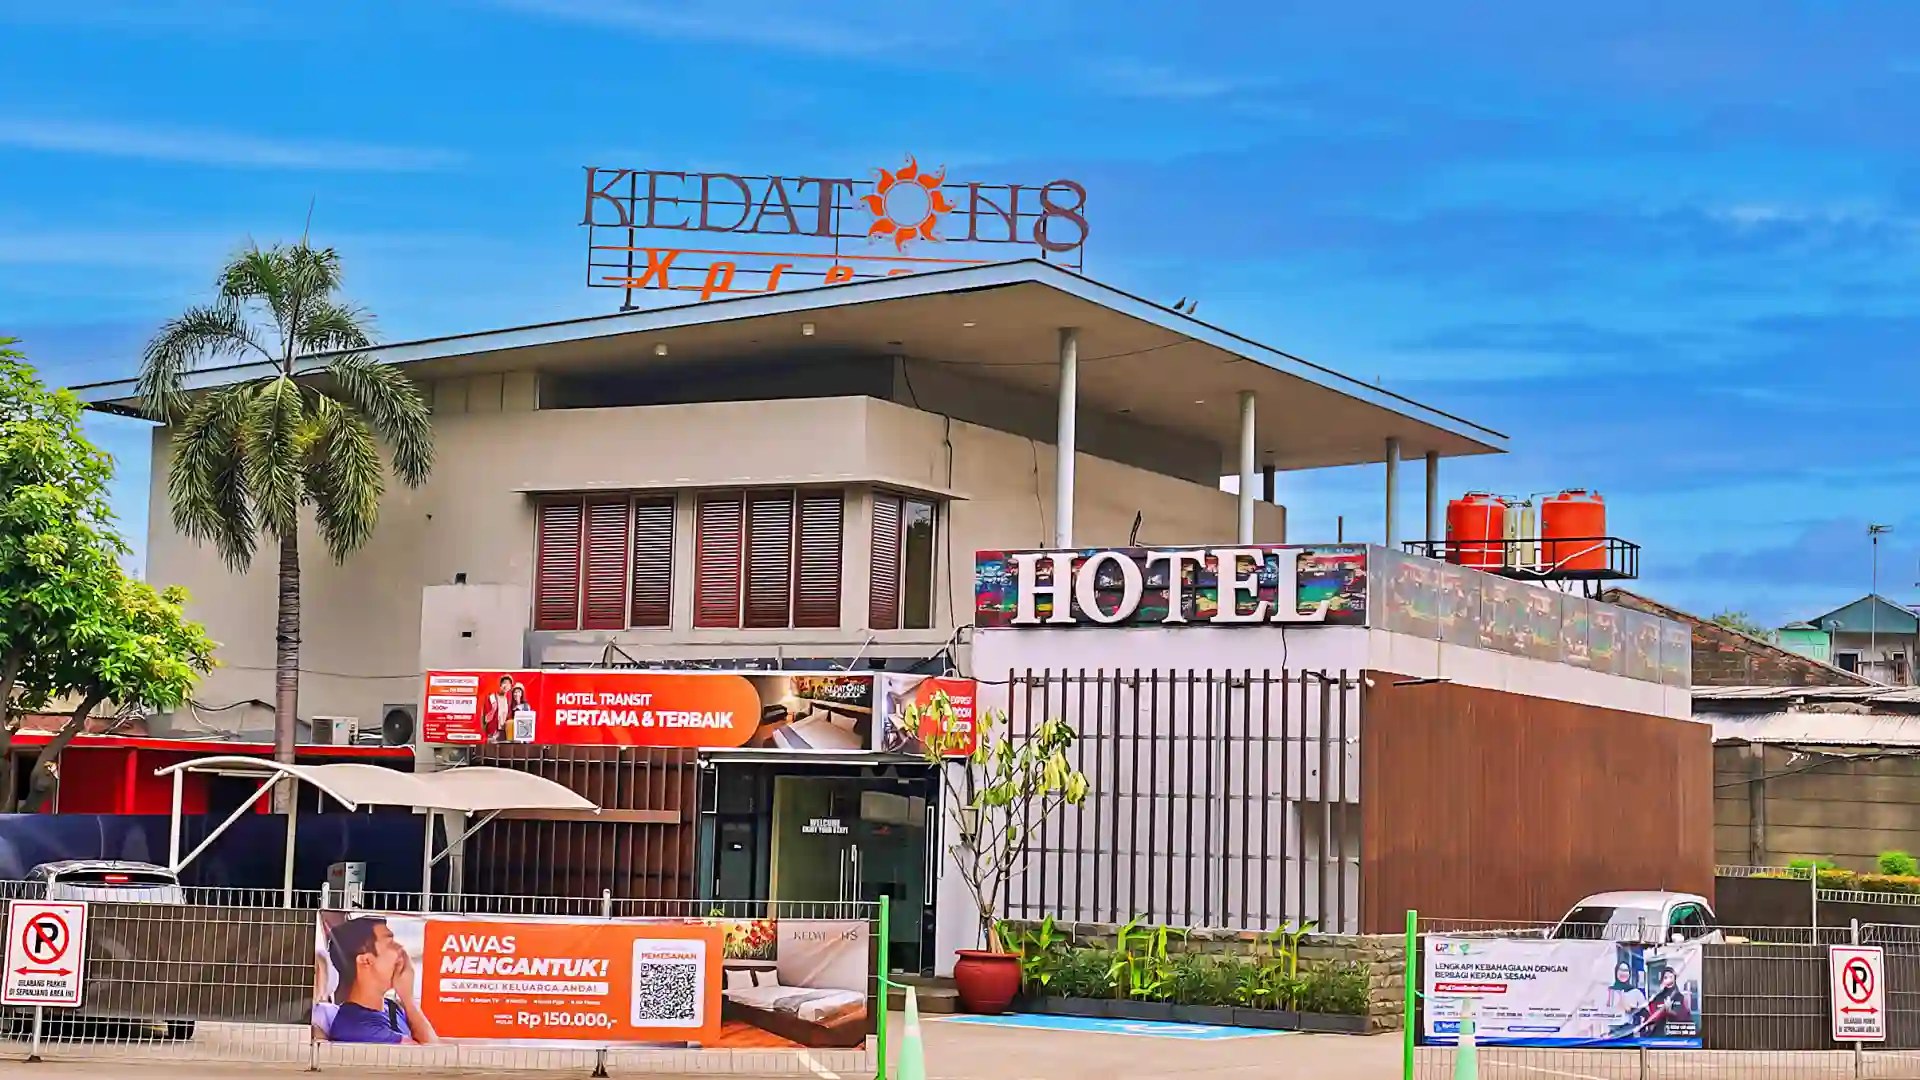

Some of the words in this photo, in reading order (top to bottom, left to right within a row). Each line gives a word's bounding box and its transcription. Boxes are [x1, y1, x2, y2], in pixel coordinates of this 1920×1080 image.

[1010, 548, 1329, 624] HOTEL
[556, 693, 597, 705] HOTEL
[599, 693, 652, 706] TRANSIT
[556, 709, 640, 727] PERTAMA
[642, 711, 654, 728] &
[656, 711, 734, 729] TERBAIK
[441, 934, 516, 954] AWAS
[641, 952, 697, 960] PEMESANAN
[440, 955, 609, 977] MENGANTUK!
[1435, 963, 1474, 971] LENGKAPI
[1475, 963, 1534, 972] KEBAHAGIAAN
[1535, 965, 1568, 973] DENGAN
[1435, 971, 1469, 979] BERBAGI
[1470, 972, 1502, 980] KEPADA
[1504, 972, 1537, 981] SESAMA
[451, 982, 498, 991] SAYANGI
[502, 983, 559, 993] KELUARGA
[518, 1012, 541, 1028] Rp
[543, 1013, 618, 1029] 150.000,-
